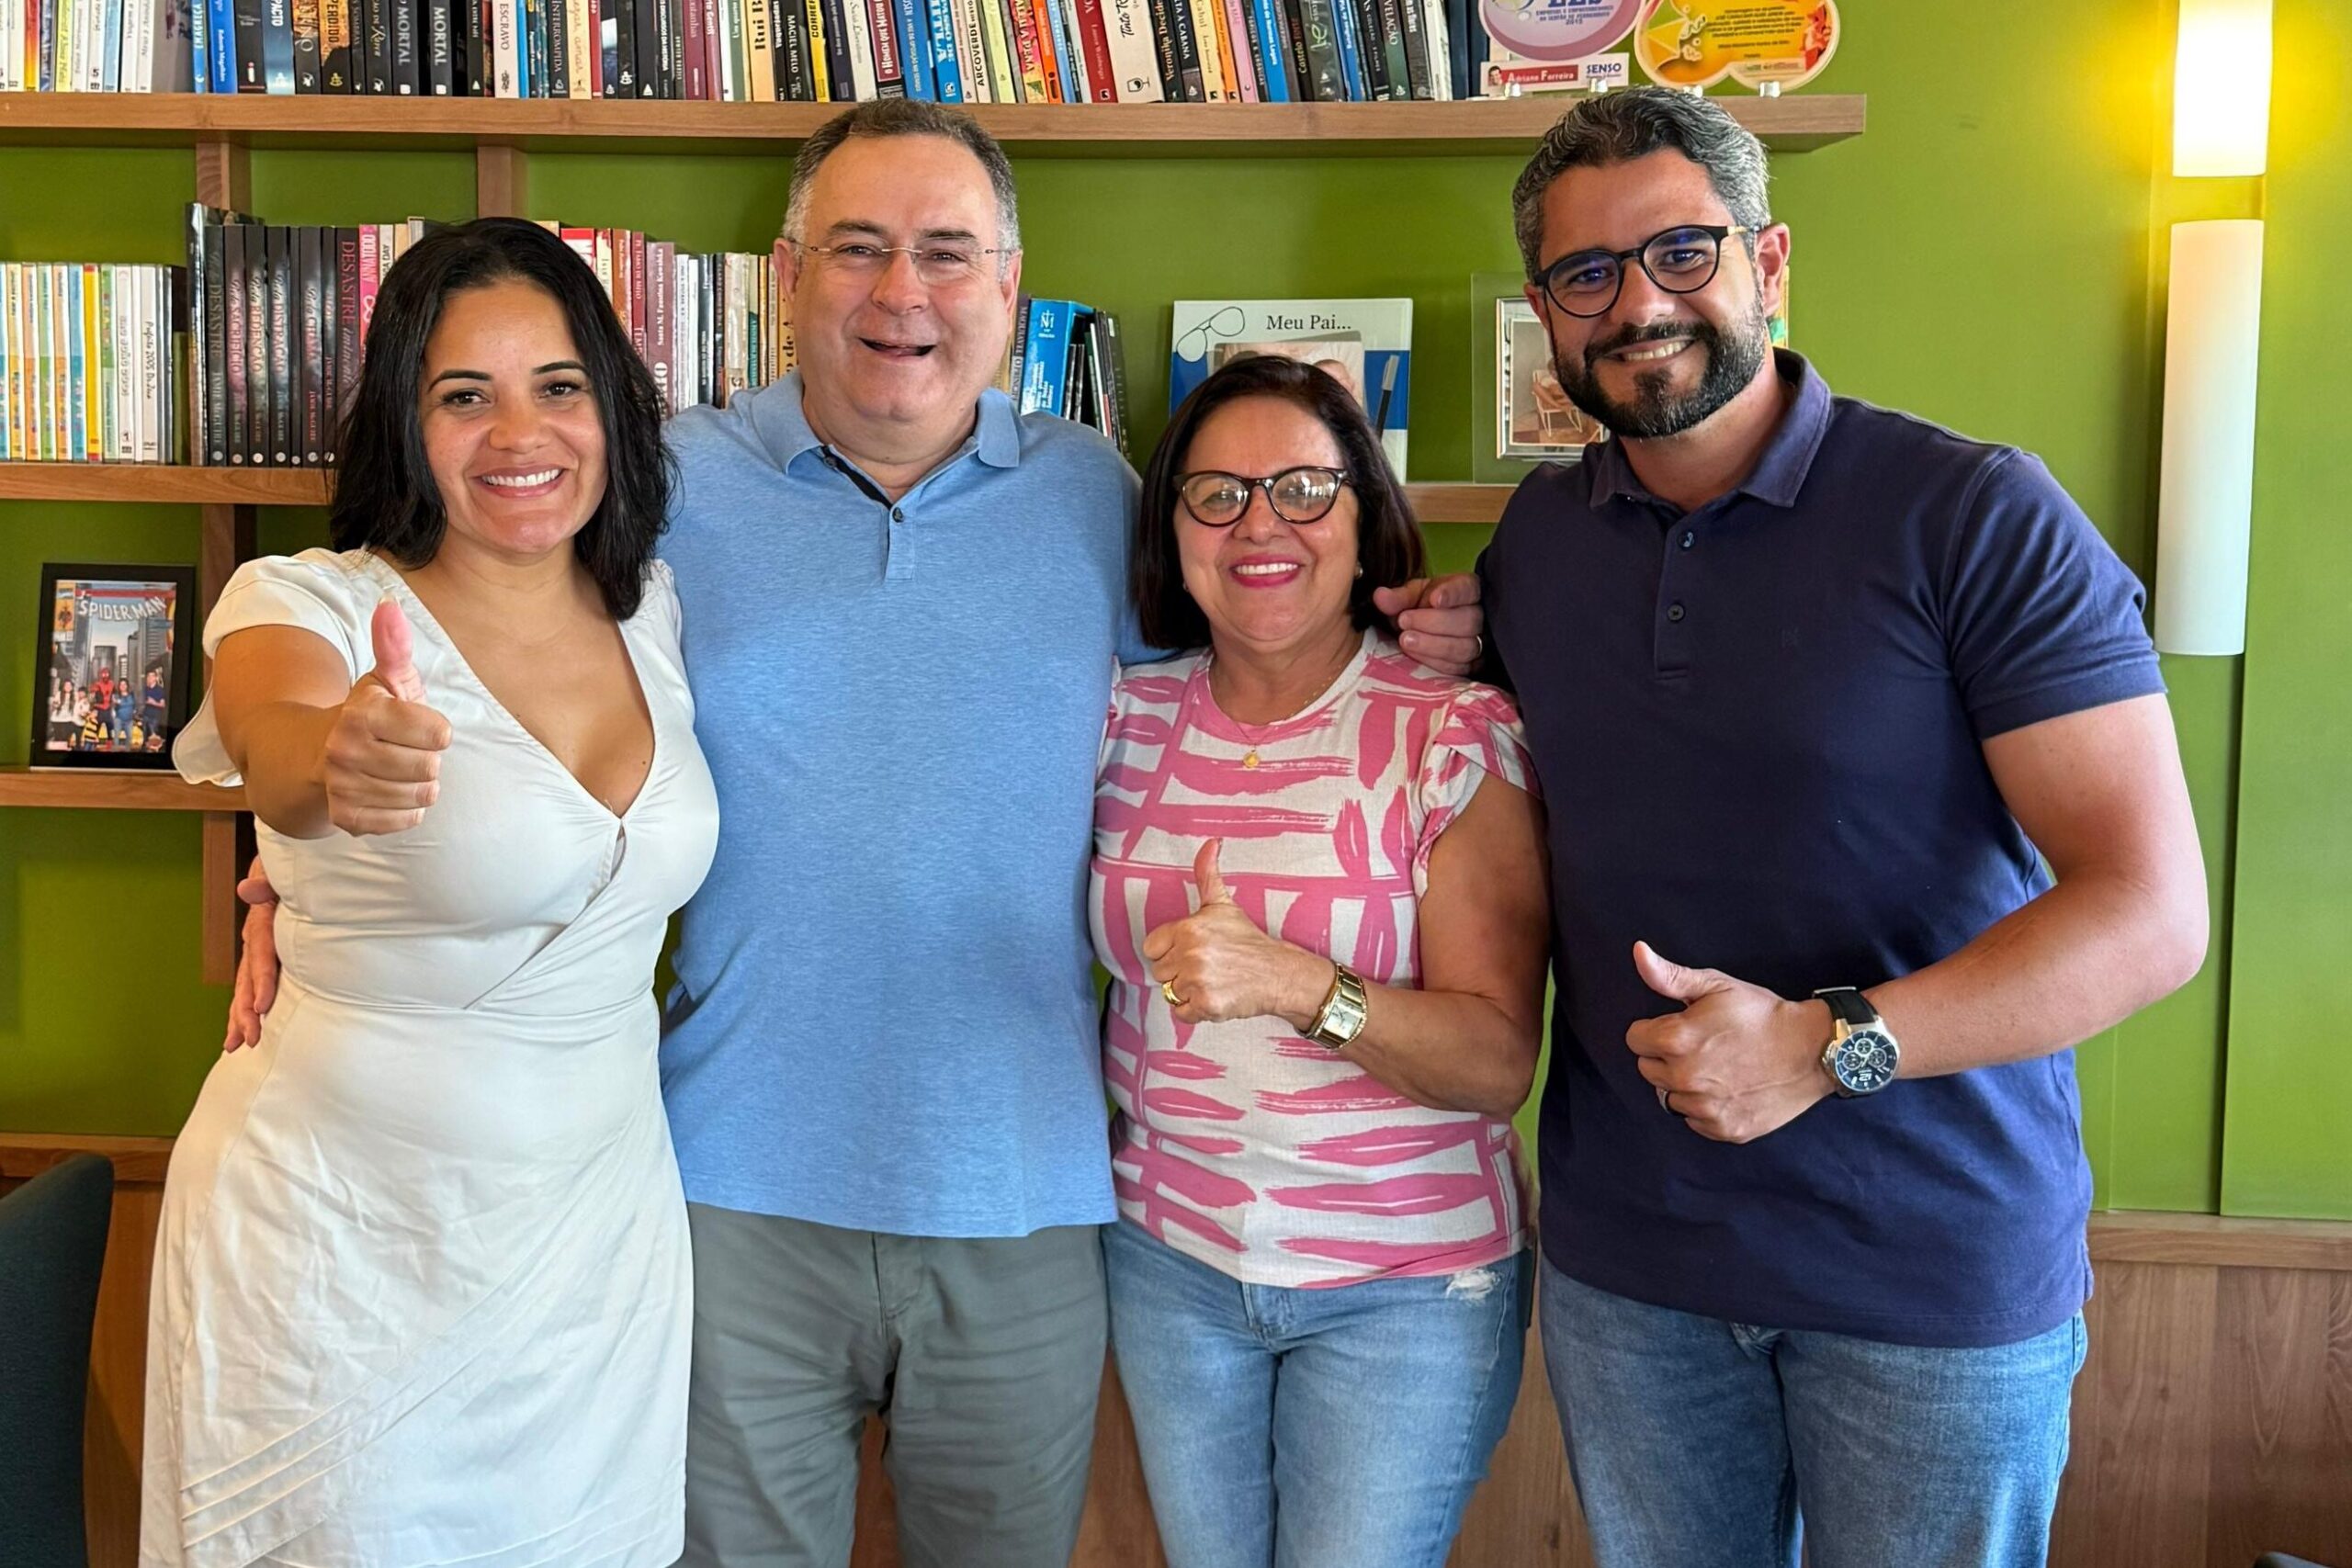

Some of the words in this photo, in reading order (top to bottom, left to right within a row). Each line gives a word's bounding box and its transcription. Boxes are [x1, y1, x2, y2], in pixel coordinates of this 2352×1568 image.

[500, 4, 510, 51] ESCRAVO
[787, 15, 797, 48] MACIEL
[1119, 12, 1135, 38] Tinto
[1155, 0, 1168, 33] Decide
[398, 7, 411, 64] MORTAL
[434, 7, 447, 65] MORTAL
[552, 0, 562, 72] INTERROMPIDA
[753, 18, 766, 50] Rui
[1179, 23, 1192, 60] CABANA
[790, 50, 798, 73] MELO
[967, 23, 985, 86] ARCOVERDE
[1160, 36, 1175, 81] Veronika
[1587, 63, 1622, 73] SENSO
[1541, 70, 1574, 81] Ferreira
[341, 241, 356, 323] DESASTRE
[656, 283, 664, 314] Faustina
[209, 284, 221, 356] DESASTRE
[657, 326, 665, 346] Santa
[1265, 314, 1304, 330] Meu
[1310, 313, 1351, 330] Pai...
